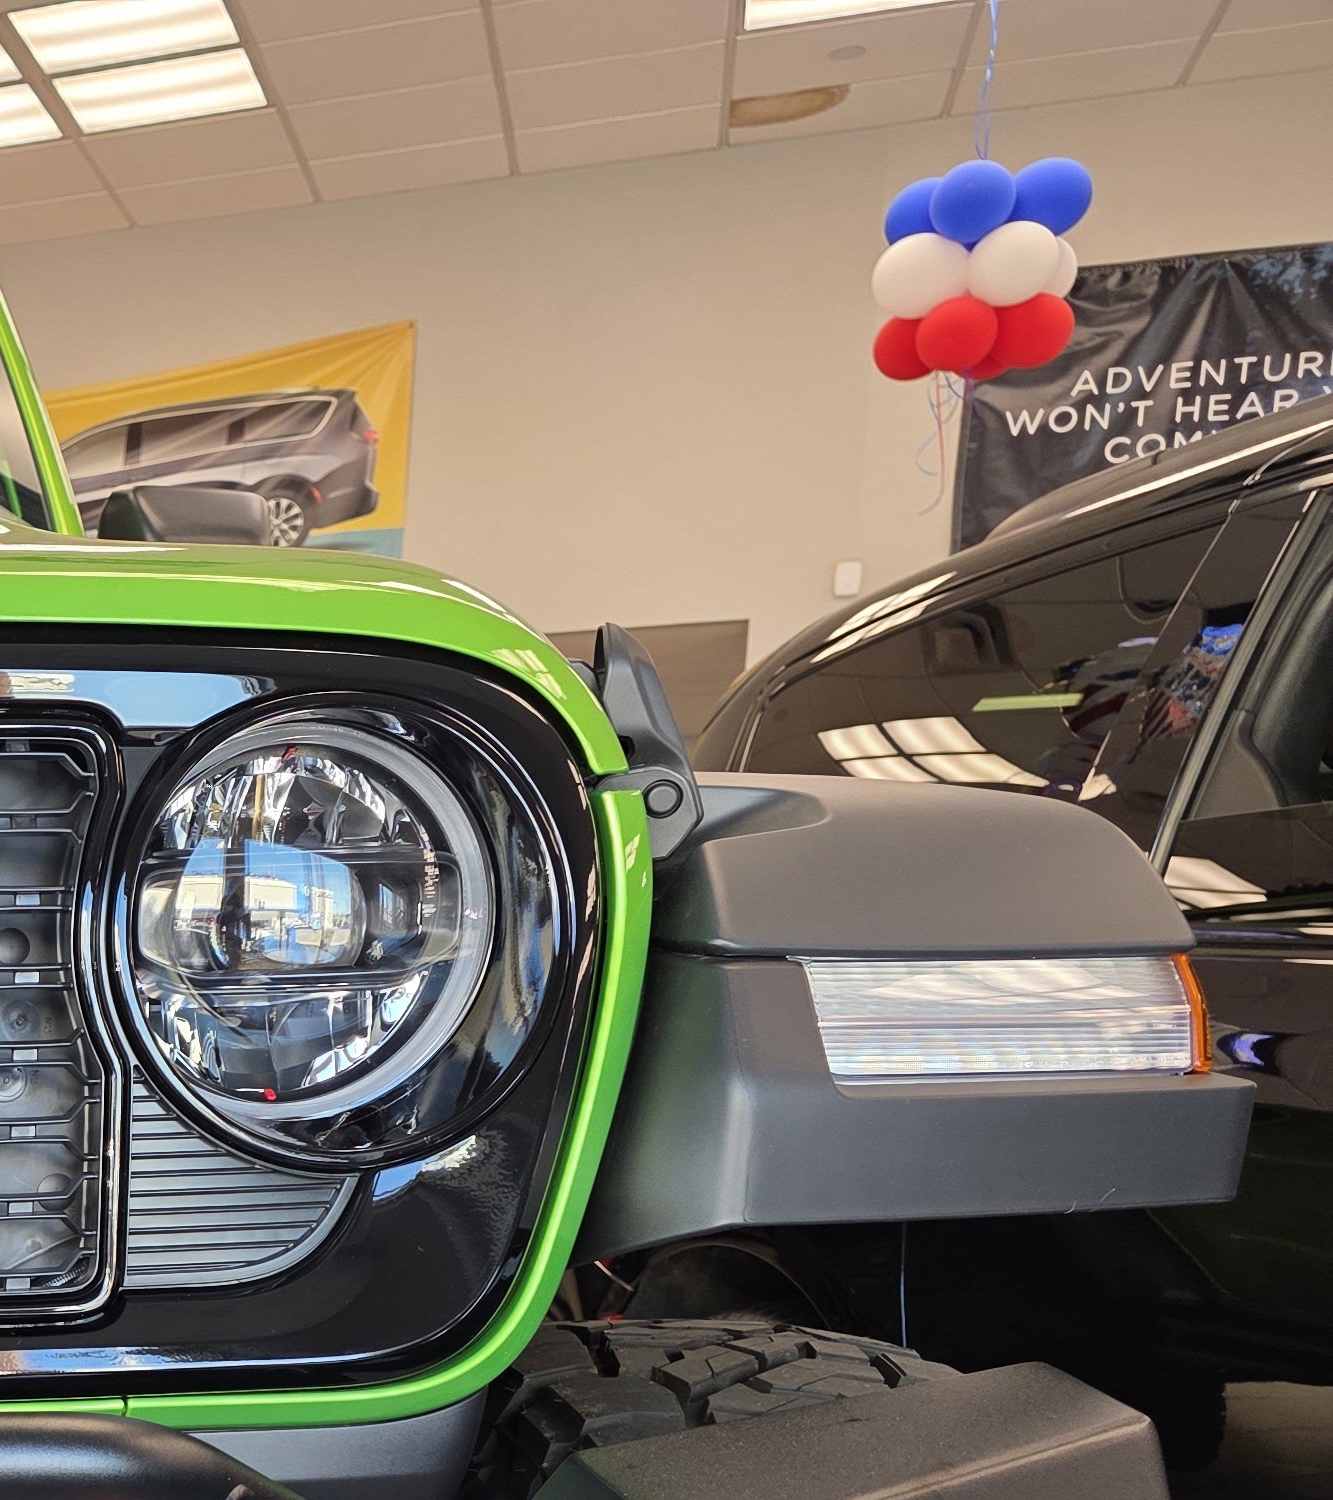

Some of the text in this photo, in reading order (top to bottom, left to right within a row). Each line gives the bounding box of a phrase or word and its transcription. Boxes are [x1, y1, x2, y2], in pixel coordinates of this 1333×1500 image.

[1070, 351, 1333, 398] ADVENTUR
[1175, 389, 1299, 423] HEAR
[1104, 429, 1218, 464] COM
